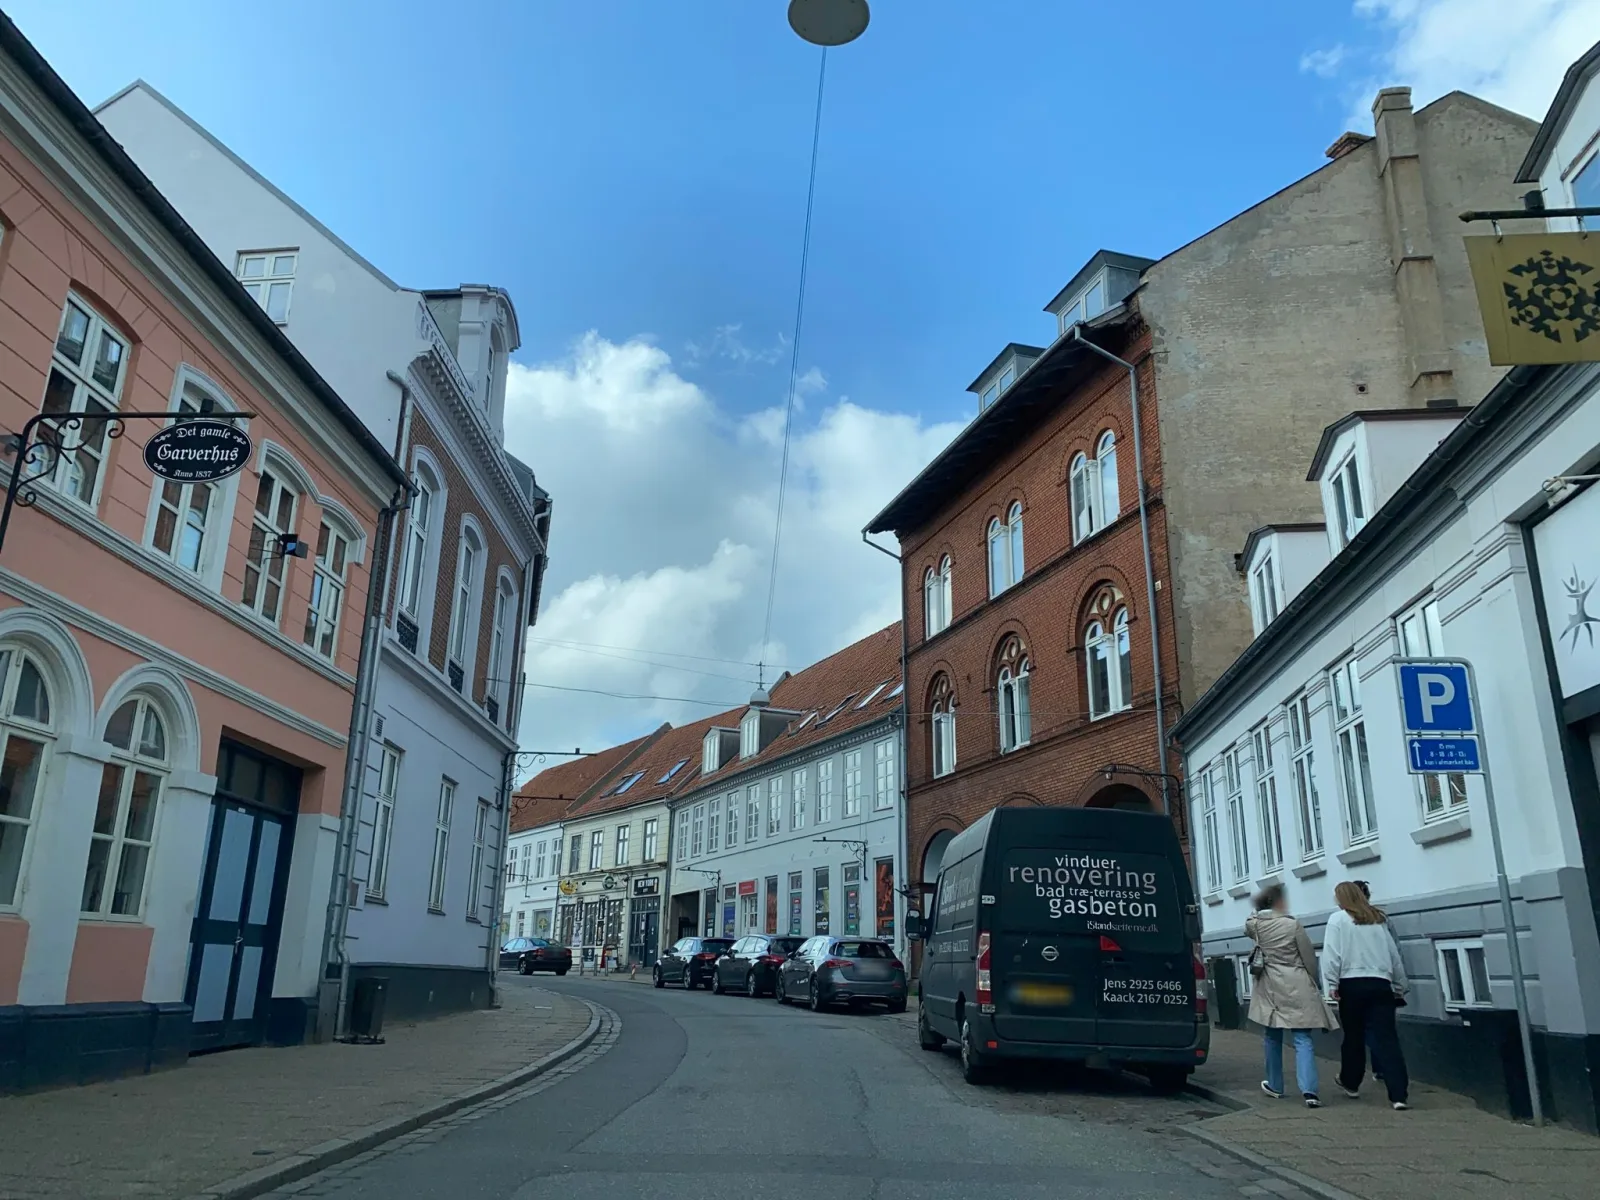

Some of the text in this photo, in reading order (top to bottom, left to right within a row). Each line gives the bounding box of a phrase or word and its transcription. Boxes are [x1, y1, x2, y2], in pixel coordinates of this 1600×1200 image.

[176, 425, 231, 439] Det gamle
[157, 443, 239, 463] Garverhus
[173, 469, 212, 478] Anno 1837
[1417, 673, 1455, 723] P
[1055, 854, 1116, 869] vinduer
[1009, 865, 1157, 895] renovering
[1035, 883, 1141, 899] bad træ-terrasse
[1049, 895, 1157, 918] gasbeton
[1104, 978, 1182, 991] Jens 2925 6466
[1103, 992, 1188, 1005] Kaack 2167 0252
